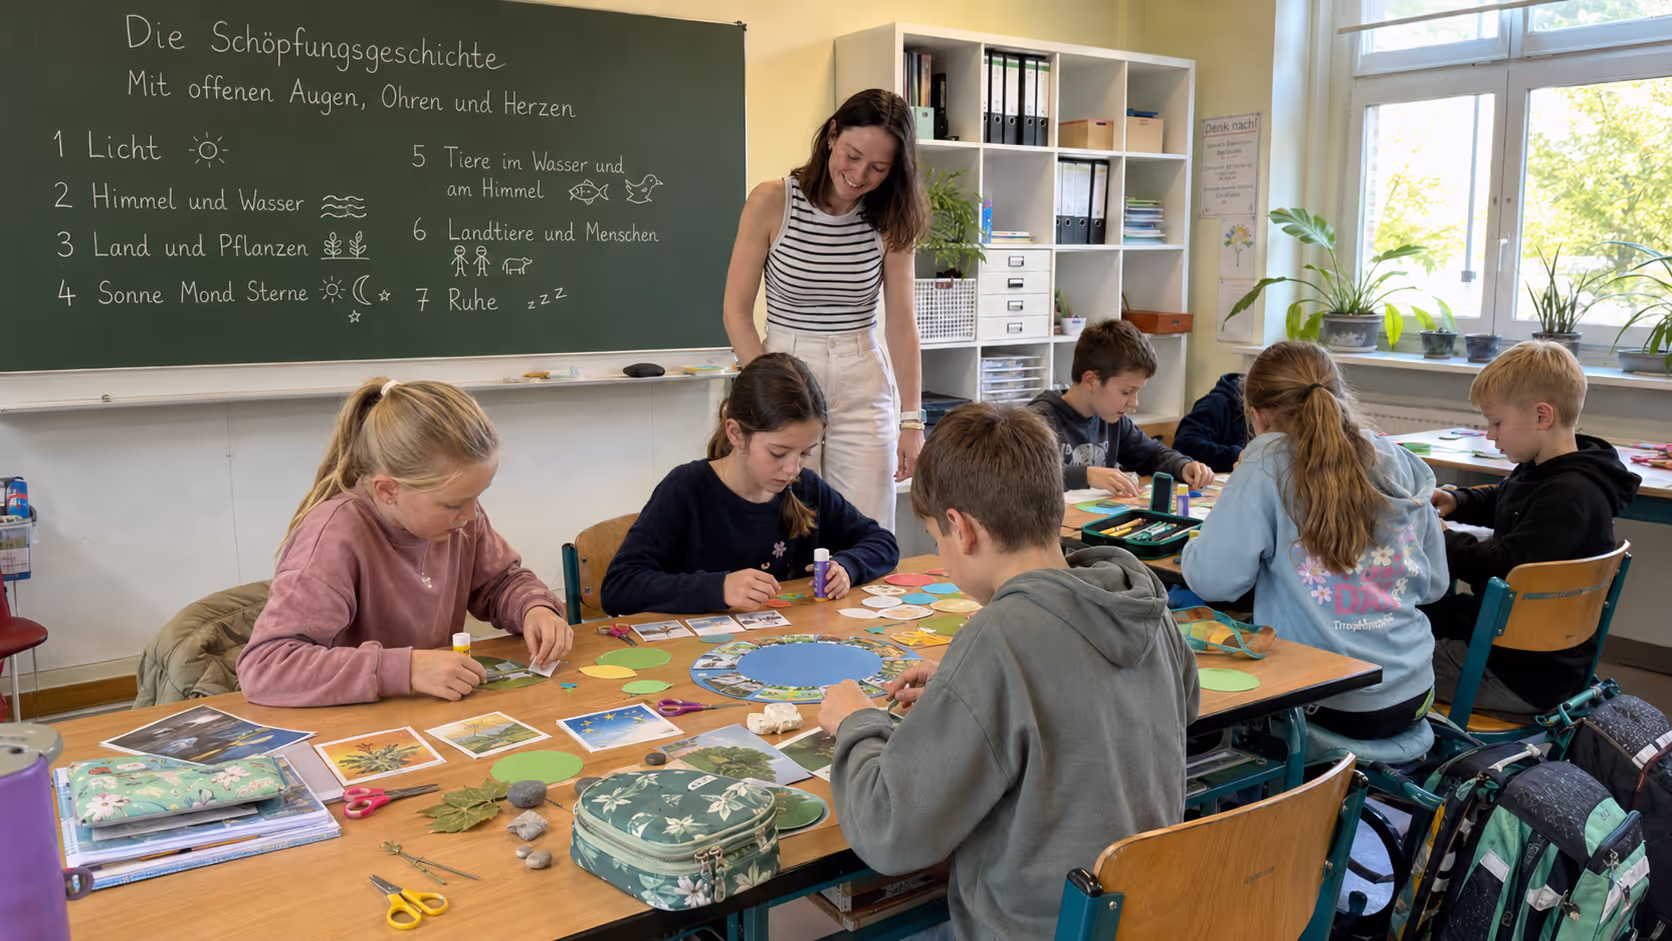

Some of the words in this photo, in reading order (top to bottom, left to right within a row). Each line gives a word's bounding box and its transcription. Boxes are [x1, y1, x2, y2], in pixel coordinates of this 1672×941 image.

[126, 14, 185, 50] Die
[211, 21, 506, 73] Schöpfungsgeschichte
[128, 70, 171, 97] Mit
[188, 74, 274, 103] offenen
[290, 78, 366, 115] Augen,
[382, 84, 443, 111] Ohren
[455, 90, 492, 113] und
[504, 91, 576, 118] Herzen
[1205, 122, 1230, 134] Denk
[1232, 118, 1258, 131] nach!
[53, 130, 64, 158] 1
[88, 130, 161, 161] Licht
[412, 144, 426, 168] 5
[444, 146, 490, 170] Tiere
[502, 153, 523, 171] im
[532, 151, 588, 173] Wasser
[595, 155, 625, 174] und
[54, 182, 73, 209] 2
[92, 182, 177, 210] Himmel
[188, 188, 228, 211] und
[239, 188, 305, 212] Wasser
[446, 184, 473, 197] am
[482, 177, 544, 199] Himmel
[413, 217, 427, 241] 6
[448, 218, 534, 242] Landtiere
[544, 222, 575, 242] und
[586, 222, 660, 243] Menschen
[57, 231, 74, 258] 3
[93, 232, 151, 258] Land
[165, 234, 206, 257] und
[219, 234, 309, 257] Pflanzen
[57, 279, 77, 307] 4
[97, 280, 164, 305] Sonne
[180, 280, 236, 304] Mond
[246, 280, 309, 302] Sterne
[415, 287, 430, 312] 7
[448, 288, 498, 311] Ruhe
